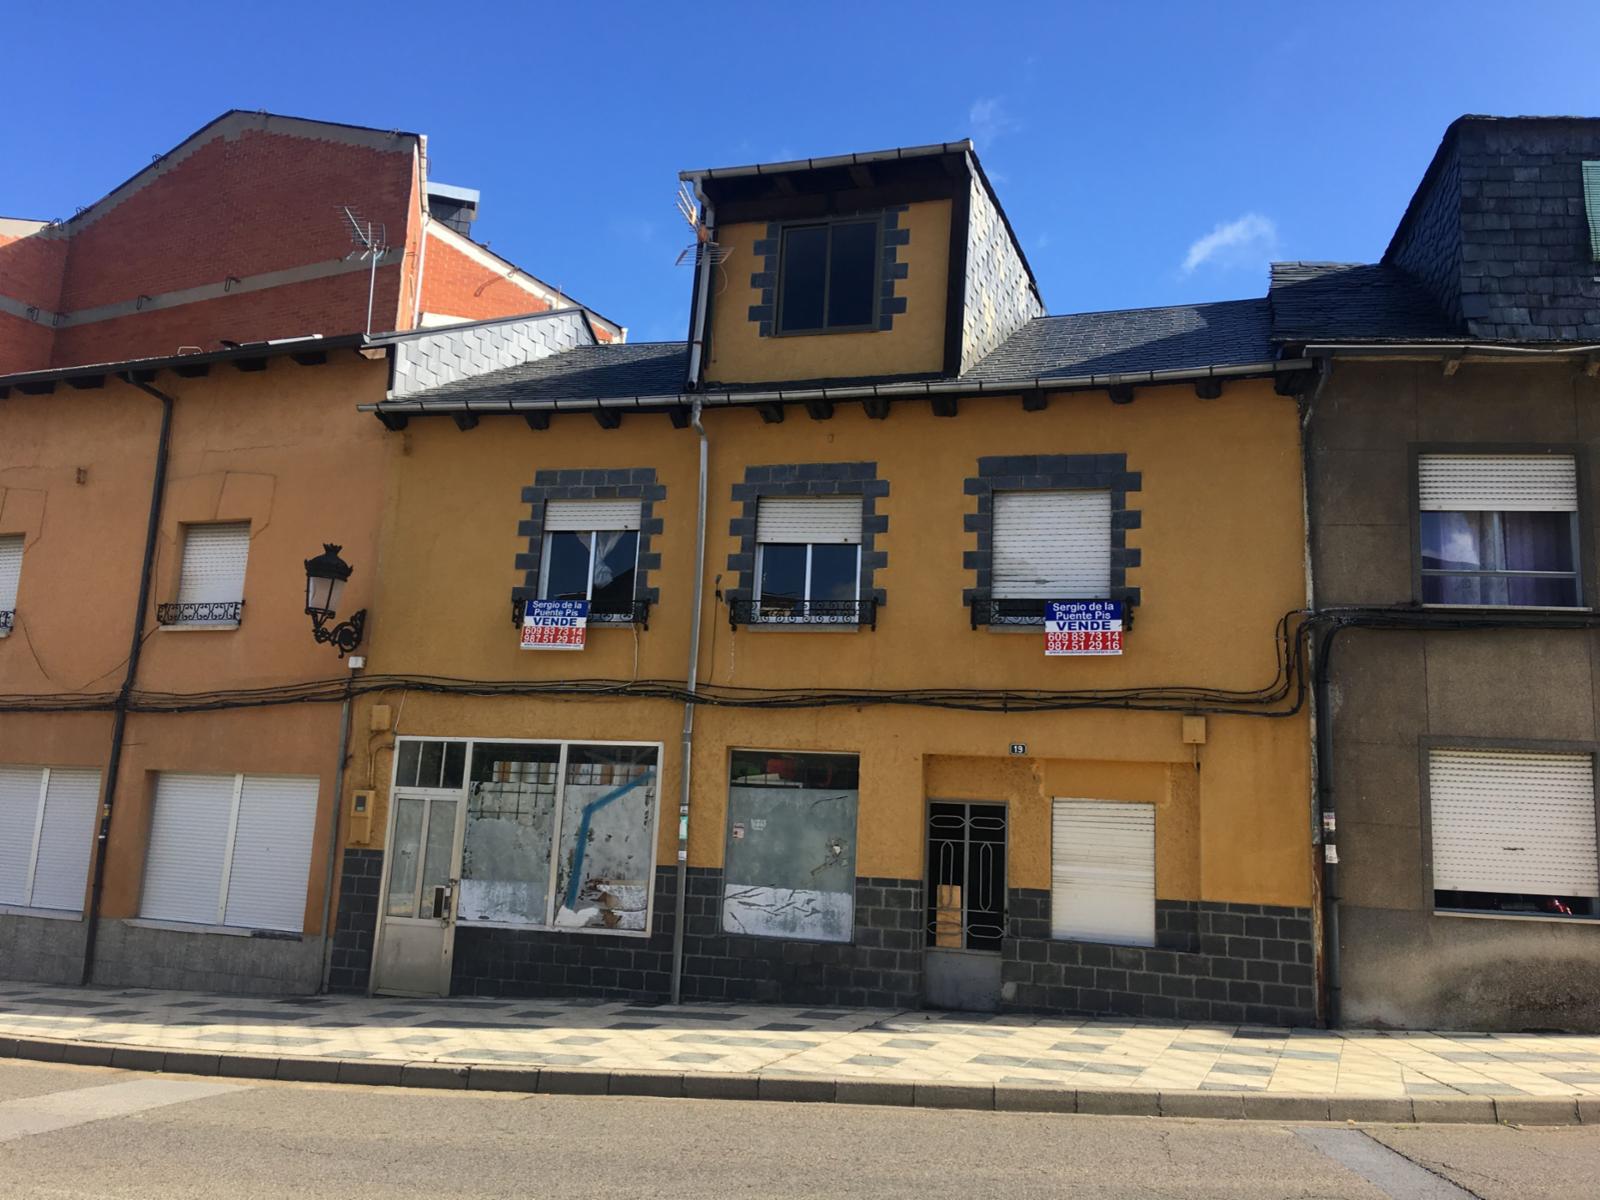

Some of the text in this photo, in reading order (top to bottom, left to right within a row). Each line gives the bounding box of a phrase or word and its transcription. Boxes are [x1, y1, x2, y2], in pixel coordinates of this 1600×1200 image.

[532, 600, 582, 610] Sergio de la
[1052, 602, 1114, 612] Sergio de la
[565, 609, 578, 617] Pis
[1056, 611, 1111, 620] Puente Pis
[533, 617, 577, 626] VENDE
[1056, 621, 1111, 631] VENDE
[1047, 632, 1119, 641] 609 83 73 14
[1047, 641, 1120, 650] 987 51 29 16
[1014, 745, 1023, 753] 19
